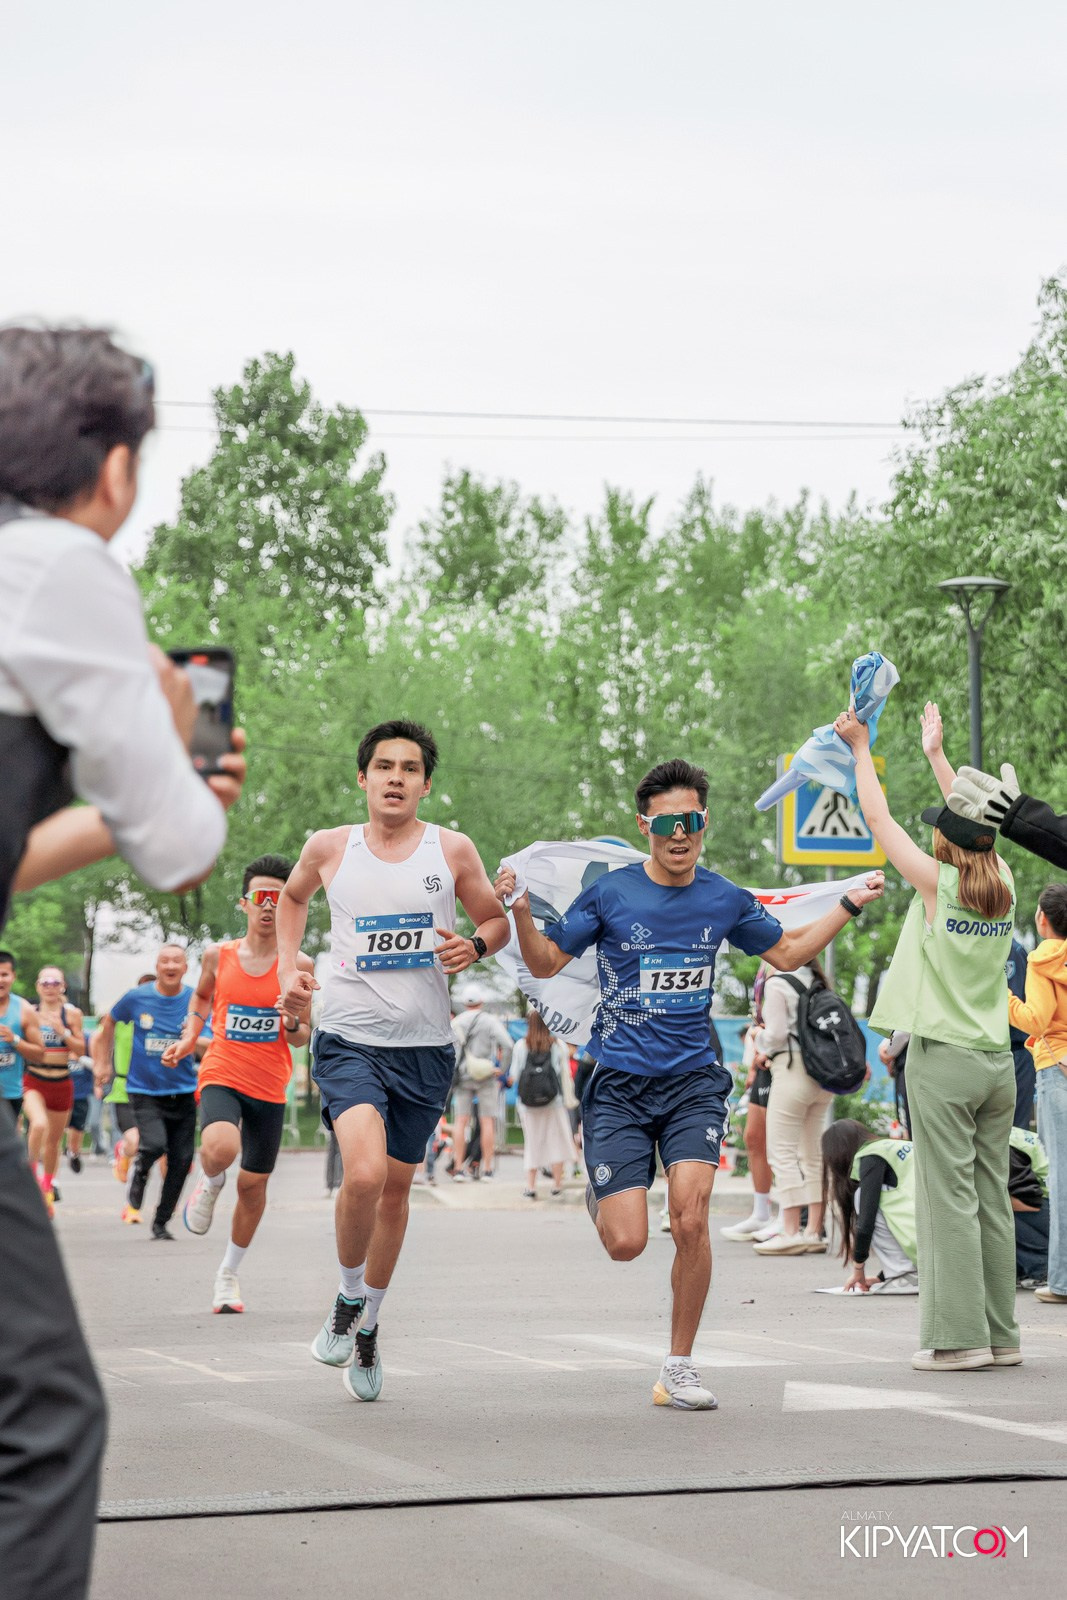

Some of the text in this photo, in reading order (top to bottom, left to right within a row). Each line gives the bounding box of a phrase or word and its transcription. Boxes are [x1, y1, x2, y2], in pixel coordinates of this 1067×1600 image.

[368, 931, 423, 952] 1801
[651, 969, 704, 991] 1334
[232, 1016, 275, 1031] 1049
